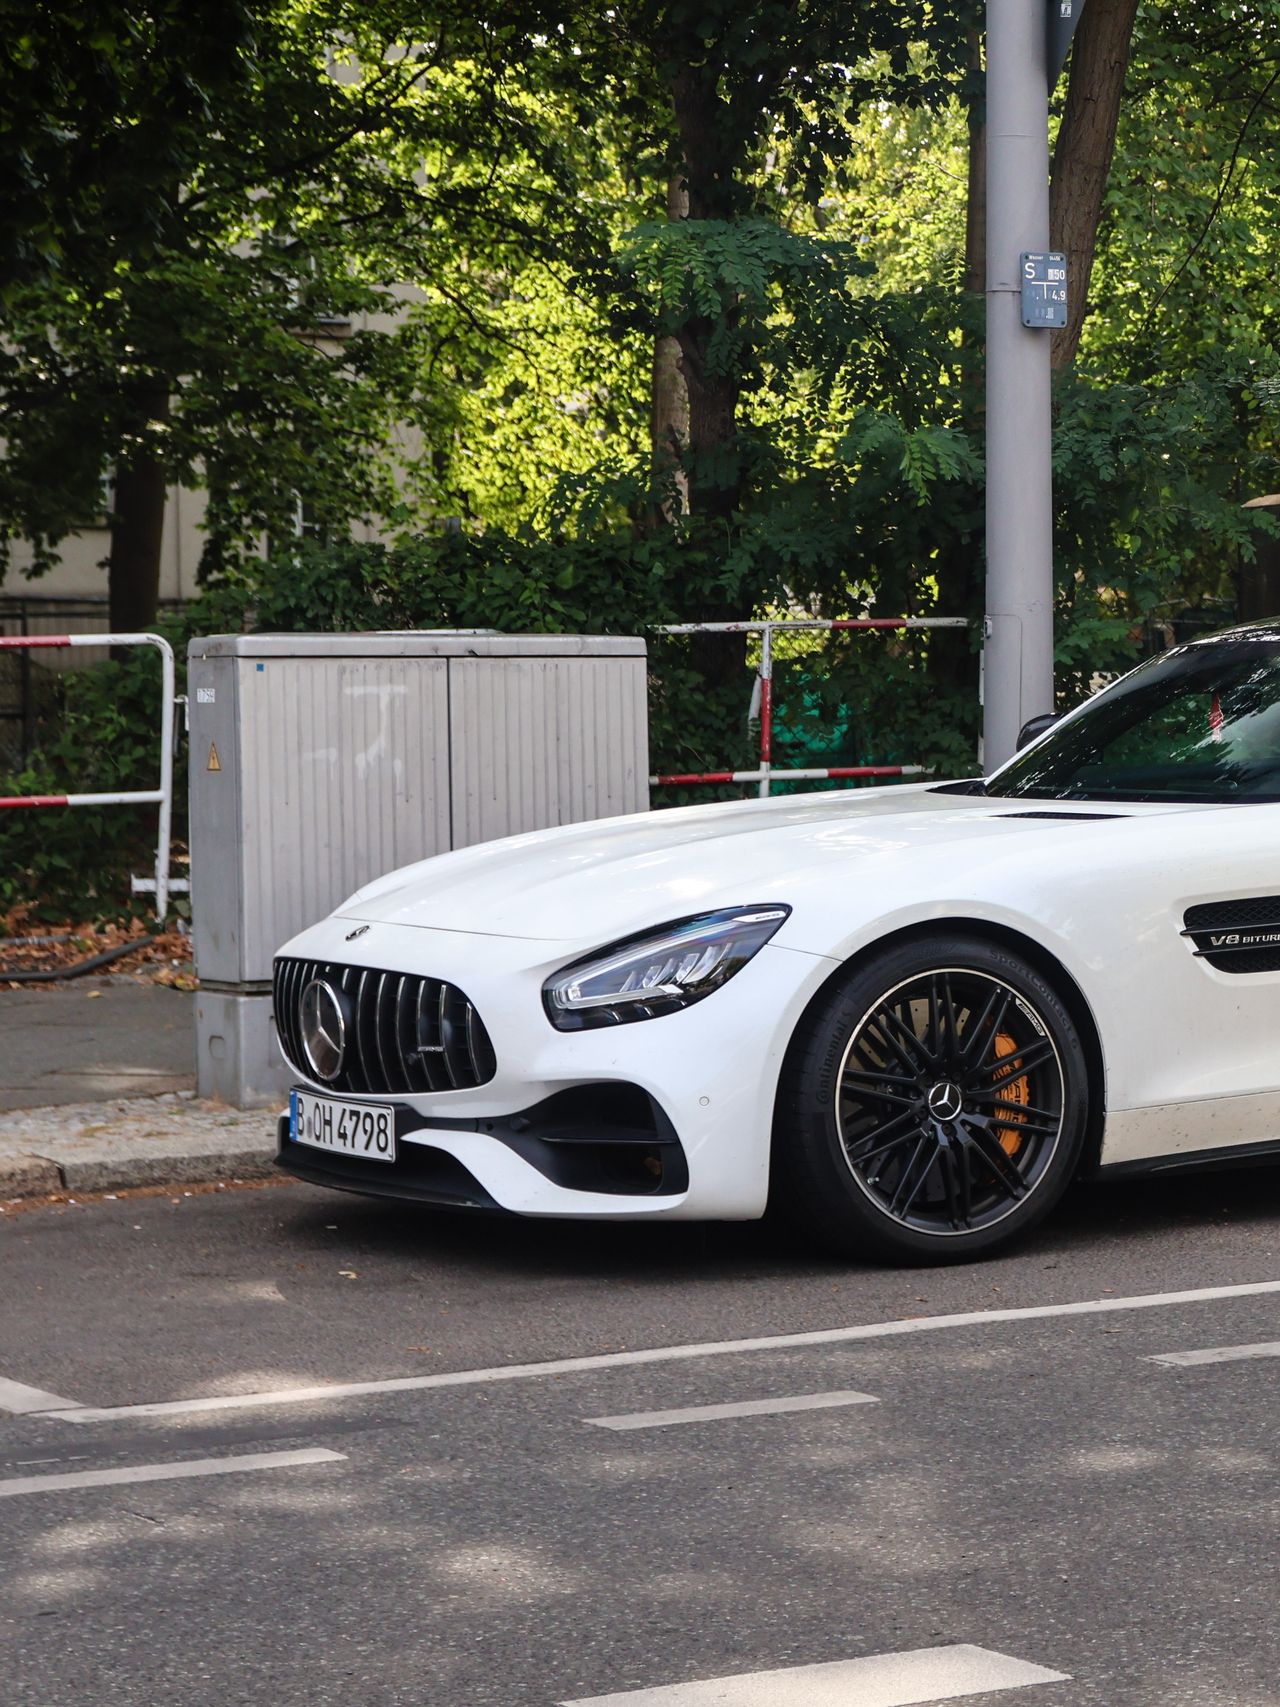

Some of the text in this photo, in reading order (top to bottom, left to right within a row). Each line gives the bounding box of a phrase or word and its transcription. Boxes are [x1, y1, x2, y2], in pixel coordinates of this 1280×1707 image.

[1025, 262, 1036, 279] S
[1052, 289, 1066, 301] 4.9
[1210, 934, 1240, 946] V8
[989, 949, 1073, 1033] SportContact
[297, 1097, 389, 1153] B OH 4798
